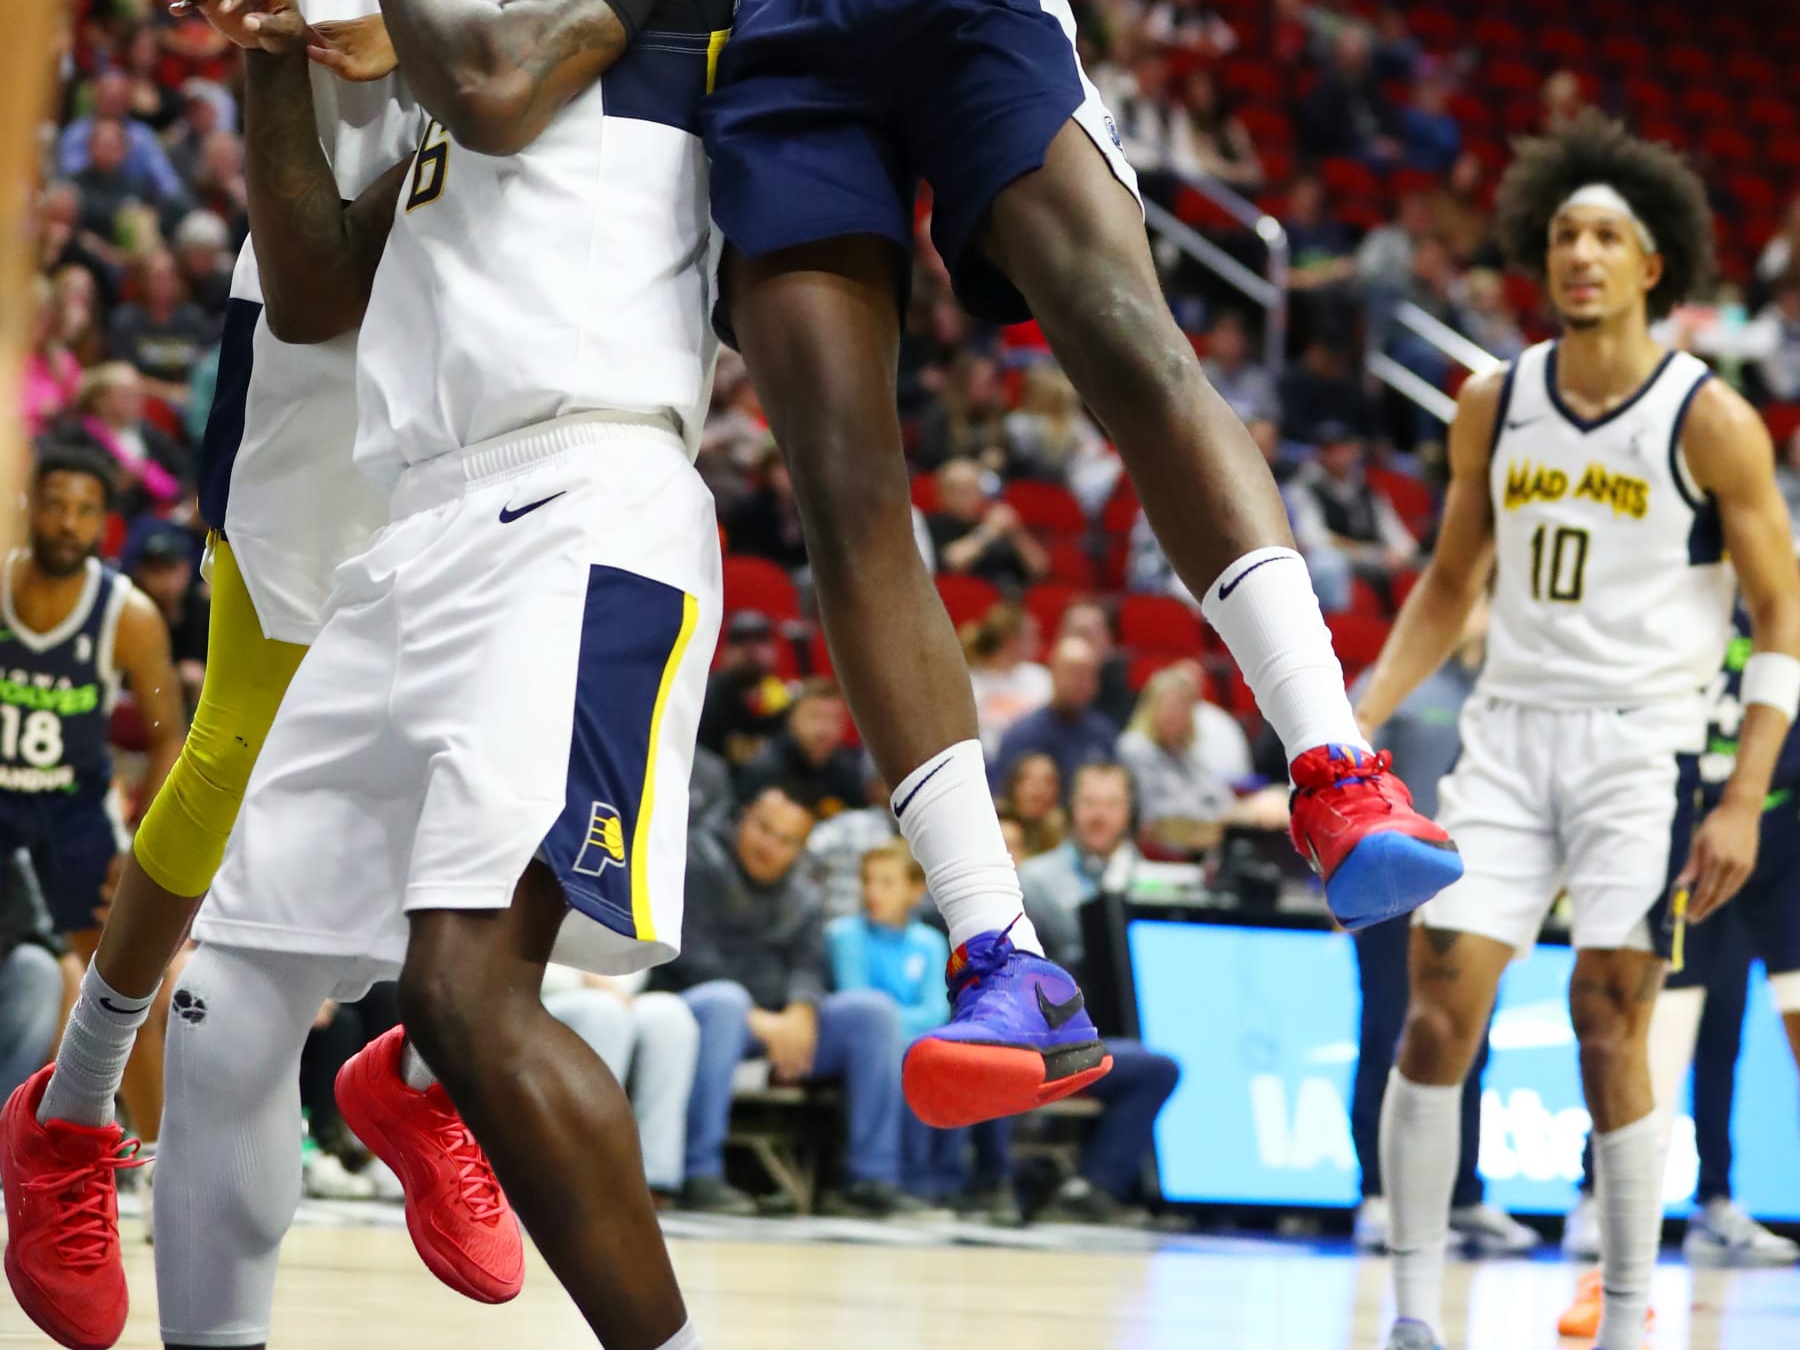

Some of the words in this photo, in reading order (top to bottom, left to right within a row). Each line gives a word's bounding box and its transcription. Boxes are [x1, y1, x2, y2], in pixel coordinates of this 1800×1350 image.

[1503, 453, 1569, 516] MAD
[1573, 458, 1650, 522] ANTS
[1531, 521, 1590, 604] 10
[0, 704, 64, 768] 18
